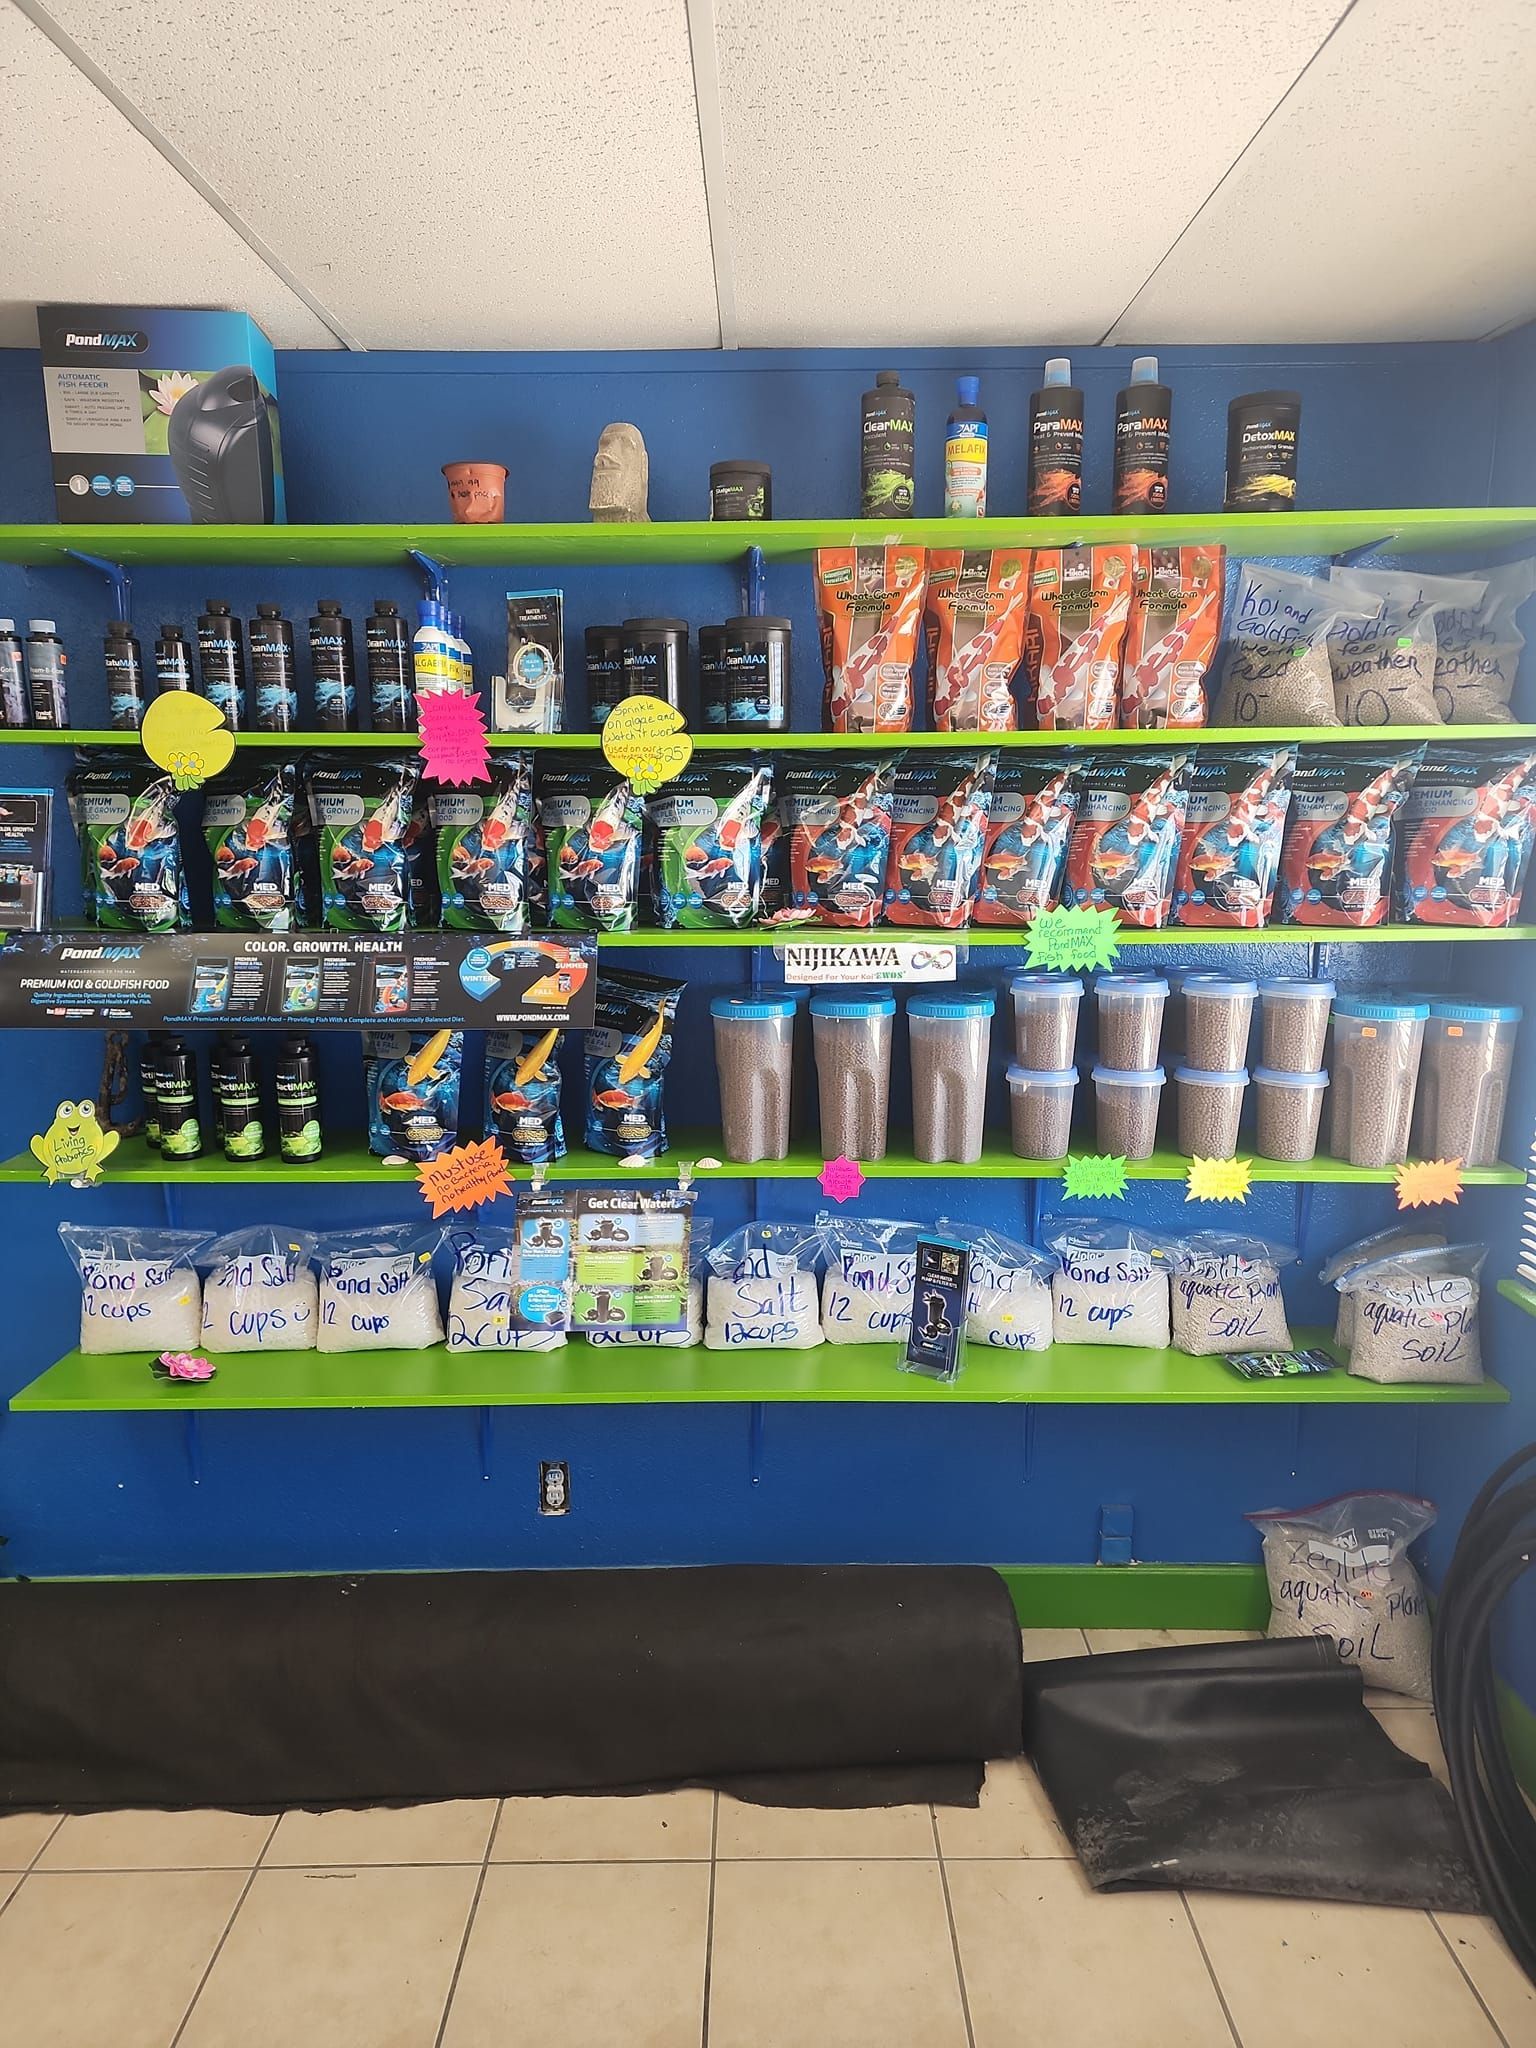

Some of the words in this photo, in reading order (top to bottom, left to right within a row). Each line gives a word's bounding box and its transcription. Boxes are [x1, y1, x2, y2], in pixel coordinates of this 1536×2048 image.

[66, 333, 137, 349] PondMAX
[57, 373, 101, 381] AUTOMATIC
[863, 418, 914, 434] ClearMAX
[1033, 417, 1083, 434] ParaMAX
[1116, 417, 1168, 434] ParaMAX
[1242, 430, 1295, 444] DetoxMAX
[947, 442, 986, 456] MELAFIX
[1064, 565, 1090, 576] Hikari
[1154, 565, 1179, 576] Hikari
[836, 590, 900, 600] Wheat-Germ
[938, 590, 1004, 600] Wheat-Germ
[1042, 589, 1108, 601] Wheat-Germ
[846, 601, 891, 612] Formula
[948, 601, 995, 612] Formula
[1052, 601, 1100, 612] Formula
[1139, 600, 1187, 611] Formula
[1285, 605, 1313, 625] and
[615, 701, 655, 716] Sprinkle
[624, 716, 656, 732] algae
[657, 712, 675, 721] and
[541, 773, 591, 784] PondMAX
[786, 769, 840, 781] PondMAX
[92, 807, 126, 815] GROWTH
[212, 807, 242, 815] GROWTH
[326, 807, 360, 815] GROWTH
[447, 807, 480, 815] GROWTH
[135, 882, 160, 891] MED
[253, 883, 278, 891] MED
[368, 883, 394, 892] MED
[487, 883, 511, 892] MED
[597, 883, 619, 892] MED
[843, 881, 865, 891] MED
[936, 878, 959, 888] MED
[1025, 878, 1048, 888] MED
[1233, 878, 1256, 888] MED
[1350, 878, 1375, 888] MED
[1478, 877, 1504, 887] MED
[1038, 920, 1104, 938] recommend
[1040, 918, 1066, 929] We
[244, 941, 290, 953] COLOR.
[293, 941, 352, 953] GROWTH.
[354, 940, 403, 953] HEALTH
[60, 944, 142, 962] PondMAX
[786, 947, 901, 971] NIJIKAWA
[786, 972, 824, 982] Designed
[825, 973, 840, 981] For
[840, 973, 860, 981] Your
[860, 972, 874, 981] Koi
[20, 978, 66, 989] PREMIUM
[67, 979, 84, 989] KOI
[85, 979, 94, 989] &
[95, 979, 142, 990] GOLDFISH
[142, 979, 170, 990] FOOD
[287, 1016, 315, 1024] Providing
[348, 1016, 377, 1024] Complete
[388, 1016, 424, 1024] Nutritionally
[496, 1013, 570, 1022] WWW.PONDMAX.COM
[413, 1115, 437, 1125] MED
[519, 1116, 542, 1126] MED
[623, 1113, 646, 1123] MED
[53, 1136, 86, 1153] Living
[54, 1145, 95, 1167] Probiotics
[588, 1197, 609, 1209] Get
[609, 1197, 639, 1209] Clear
[639, 1198, 676, 1209] Water!
[731, 1276, 809, 1320] Salt
[1180, 1280, 1246, 1310] aquatic
[100, 1301, 152, 1322] cups
[828, 1292, 853, 1322] 12
[1058, 1294, 1079, 1318] 12
[1087, 1303, 1135, 1331] cups
[322, 1301, 337, 1325] 12
[350, 1314, 390, 1335] cups
[1363, 1301, 1434, 1335] aquatic
[229, 1307, 287, 1343] cups
[988, 1329, 1037, 1351] cups
[1280, 1579, 1371, 1620] aquatic
